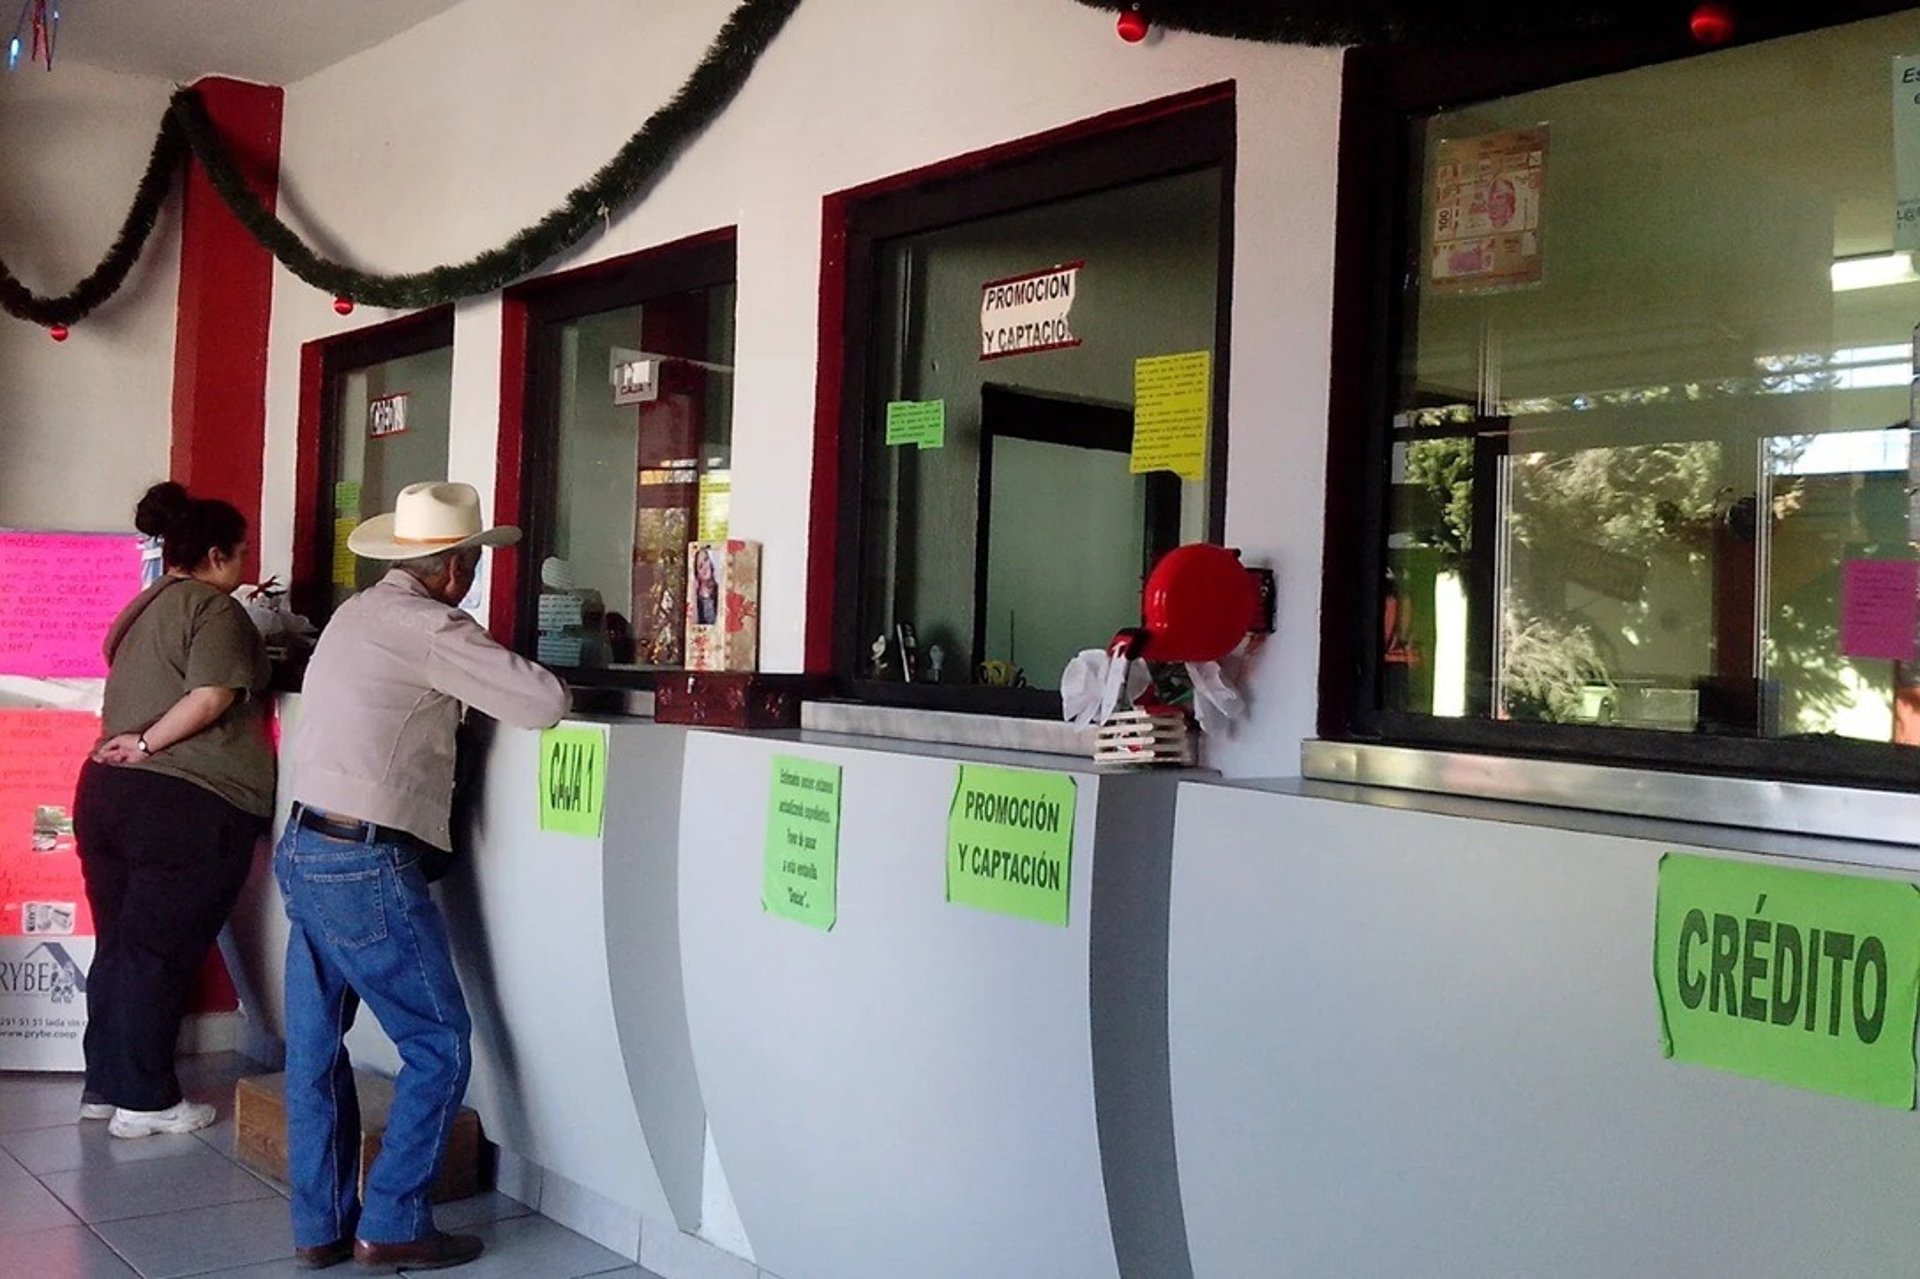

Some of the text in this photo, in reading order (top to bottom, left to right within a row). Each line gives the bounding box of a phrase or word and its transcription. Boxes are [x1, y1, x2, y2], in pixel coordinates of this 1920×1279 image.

[984, 312, 1070, 352] Y CAPTACIÓ
[550, 742, 595, 813] CAJA 1
[965, 789, 1060, 833] PROMOCIÓN
[958, 843, 1060, 891] Y CAPTACIÓN
[1677, 893, 1888, 1044] CRÉDITO
